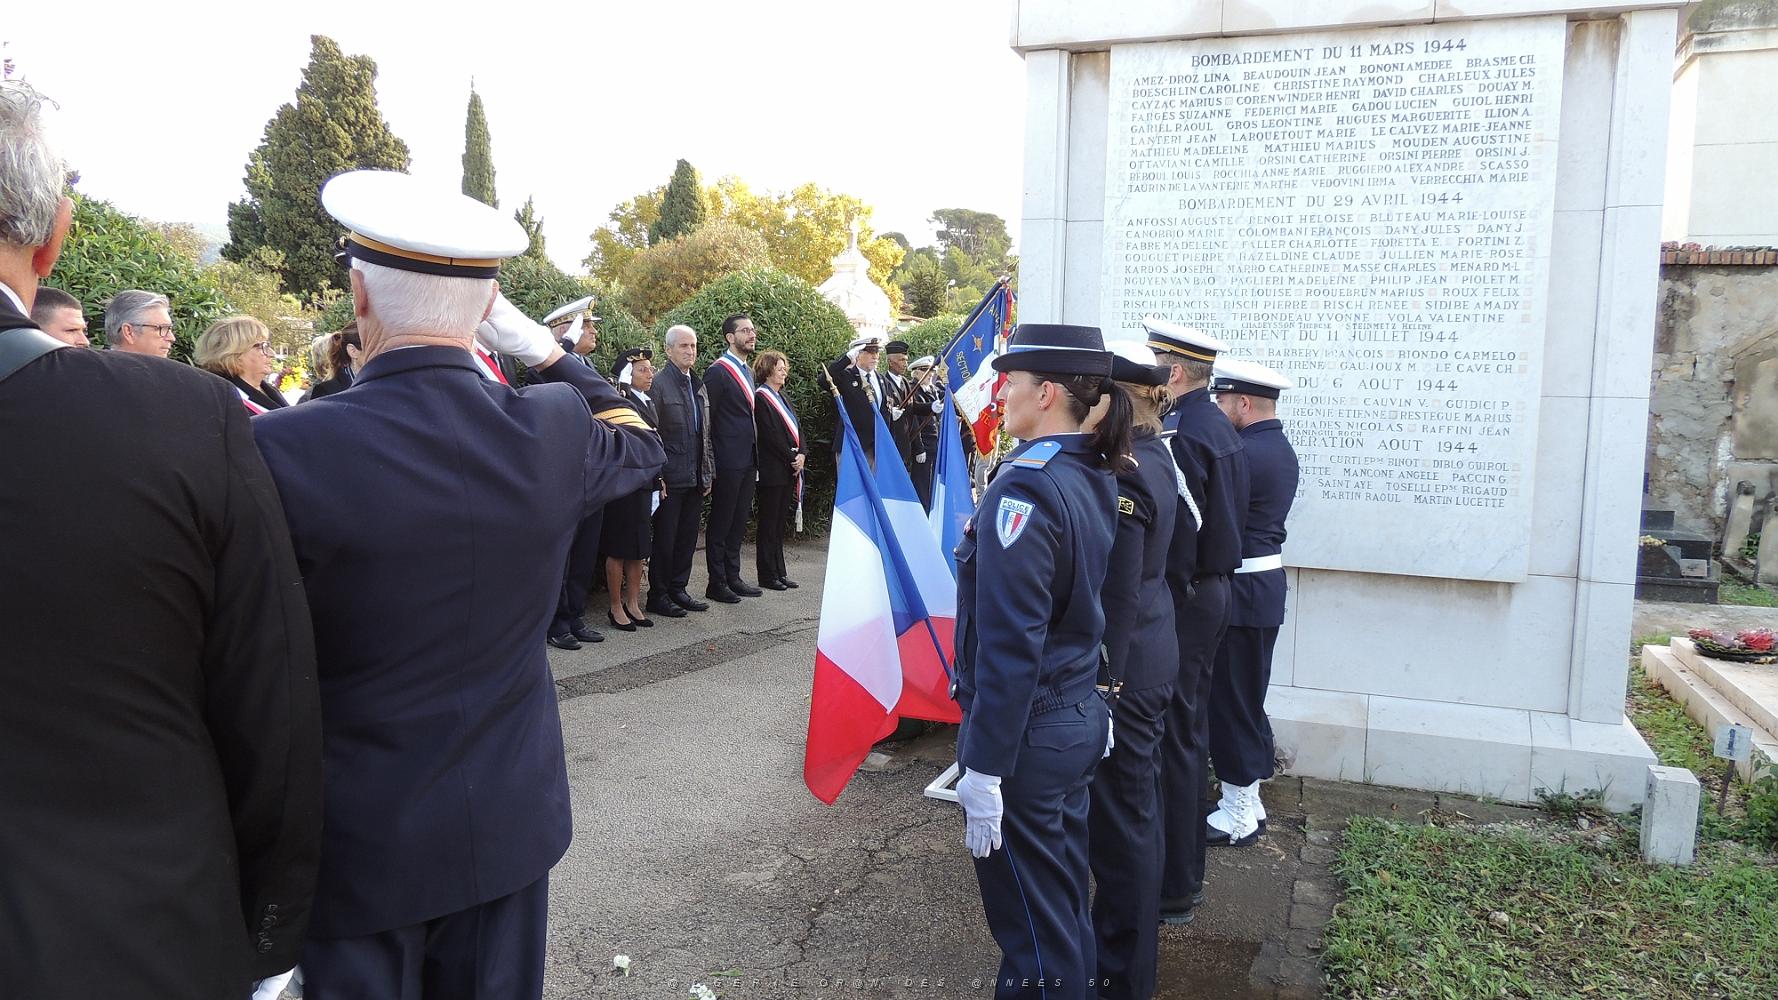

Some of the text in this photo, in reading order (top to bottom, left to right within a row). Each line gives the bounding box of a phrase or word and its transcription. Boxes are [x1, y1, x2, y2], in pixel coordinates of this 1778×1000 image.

[1191, 38, 1467, 67] BOMBARDEMENT DU 11 MARS 1944
[1133, 56, 1517, 86] AMEZ-DROZ LINA BEAUDOUIN JEAN BONONI AMEDEE BRASME
[1199, 82, 1260, 94] CAROLINE
[1273, 78, 1340, 91] CHRISTINE
[1342, 74, 1403, 87] RAYMOND
[1417, 70, 1491, 83] CHARLEUX
[1493, 67, 1536, 79] JULES
[1131, 82, 1518, 110] CAYZAC MARIUS HENRI DAVID CHARLES DOUAY
[1178, 108, 1232, 119] SUZANNE
[1243, 105, 1296, 116] FEDERICI
[1299, 103, 1338, 114] MARIE
[1351, 100, 1392, 111] GADOU
[1394, 98, 1437, 109] LUCIEN
[1451, 95, 1493, 106] GUIOL
[1494, 93, 1533, 104] HENRI
[1130, 108, 1519, 134] GARIEL RAOUL GROS LEONTINE HUGUES MARGUERITE ILION
[1129, 120, 1532, 146] LANTERI JEAN MARIE LE CALVEZ MARIE-JEANNE
[1130, 133, 1531, 157] MATHIEU MADELEINE MATHIEU MARIUS MOUDEN AUGUSTINE
[1128, 146, 1517, 169] OTTAVIANI CAMILLE ORSINI CATHERINE ORSINI PIERRE ORSINI
[1337, 164, 1392, 175] RUGGIERO
[1394, 161, 1464, 173] ALEXANDRE
[1479, 159, 1529, 170] SCASSO
[1127, 183, 1166, 192] TAURIN
[1252, 179, 1298, 189] MARTHE
[1367, 176, 1396, 185] IRMA
[1410, 173, 1485, 184] VERRECCHIA
[1488, 172, 1529, 182] MARIE
[1178, 191, 1464, 210] BOMBARDEMENT DU 29 AVRIL 1944
[1126, 210, 1526, 226] ANFOSSI AUGUSTE HELOISE BLUTEAU MARIE-LOUISE
[1237, 223, 1512, 237] COLOMBANI DANY JULES DANY
[1125, 241, 1161, 250] FABRE
[1288, 238, 1358, 248] CHARLOTTE
[1457, 236, 1509, 246] FORTINI
[1181, 248, 1523, 261] PIERRE CLAUDE JULLIEN MARIE-ROSE
[1172, 261, 1499, 273] JOSEPH CATHERINE MASSE CHARLES MENARD
[1192, 276, 1216, 285] BAO
[1287, 275, 1355, 285] MADELEINE
[1369, 275, 1411, 284] PHILIP
[1415, 274, 1447, 284] JEAN
[1168, 288, 1191, 297] GUY
[1250, 288, 1292, 296] LOUISE
[1380, 288, 1424, 296] MARIUS
[1442, 287, 1478, 296] ROUX
[1482, 287, 1521, 296] FELIX
[1122, 300, 1157, 309] RISCH
[1263, 300, 1308, 309] PIERRE
[1322, 300, 1363, 309] RISCH
[1368, 300, 1408, 309] RENEE
[1473, 300, 1520, 310] AMADY
[1176, 312, 1505, 322] ANDRE TRIBONDEAU YVONNE VOLA VALENTINE
[1298, 330, 1459, 342] DU JUILLET 1944
[1397, 350, 1516, 360] BIONDO CARMELO
[1455, 363, 1491, 373] CAVE
[1297, 376, 1458, 391] DU AOUT 1944
[1362, 397, 1496, 409] CAUVIN GUIDICI
[1463, 412, 1512, 422] MARIUS
[1345, 421, 1511, 435] NICOLAS RAFFINI JEAN
[1376, 438, 1479, 453] AOUT 1944
[1317, 479, 1508, 496] SAINT TOSELLI RIGAUD
[1322, 490, 1361, 501] MARTIN
[1364, 492, 1401, 503] RAOUL
[1002, 499, 1031, 511] POLICE
